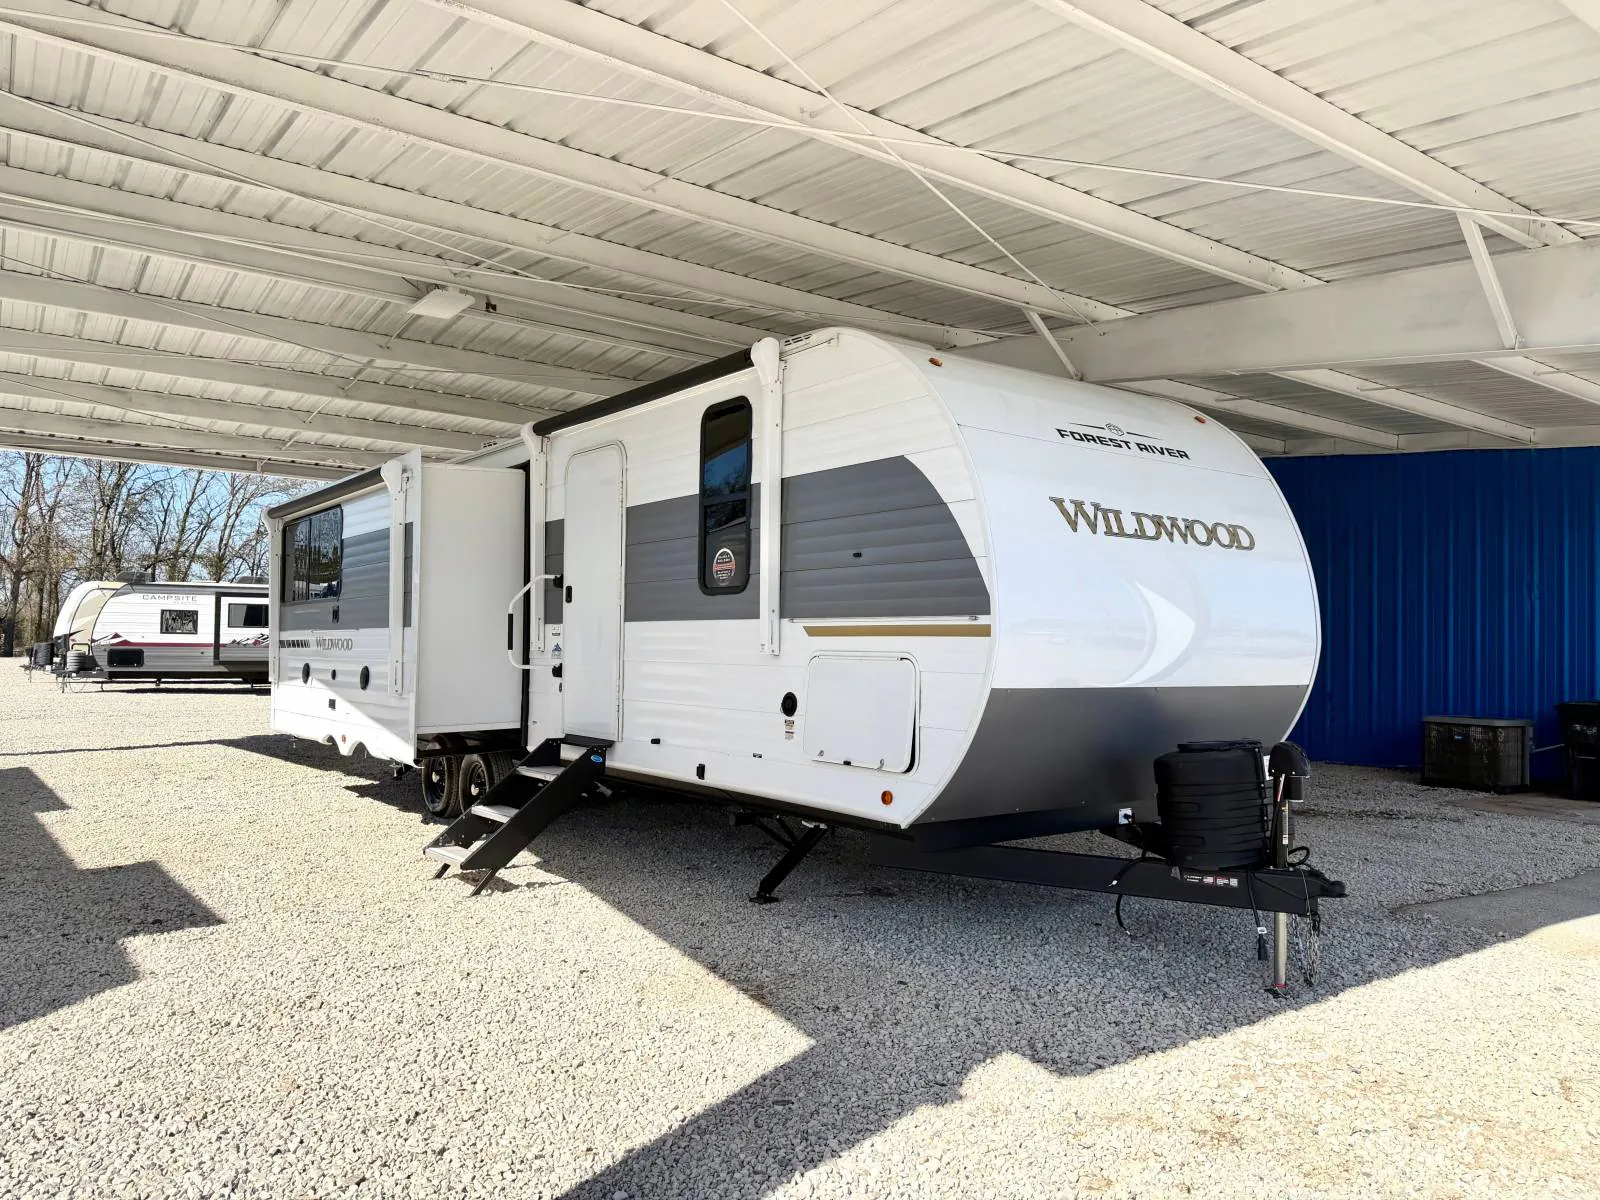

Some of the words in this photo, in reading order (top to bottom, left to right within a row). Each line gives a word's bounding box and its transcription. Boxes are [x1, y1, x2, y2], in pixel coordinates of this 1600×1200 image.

[1056, 428, 1132, 450] FOREST
[1135, 441, 1191, 460] RIVER
[1049, 496, 1256, 551] WILDWOOD
[142, 594, 198, 602] CAMPSITE
[315, 636, 353, 651] WILDWOOD
